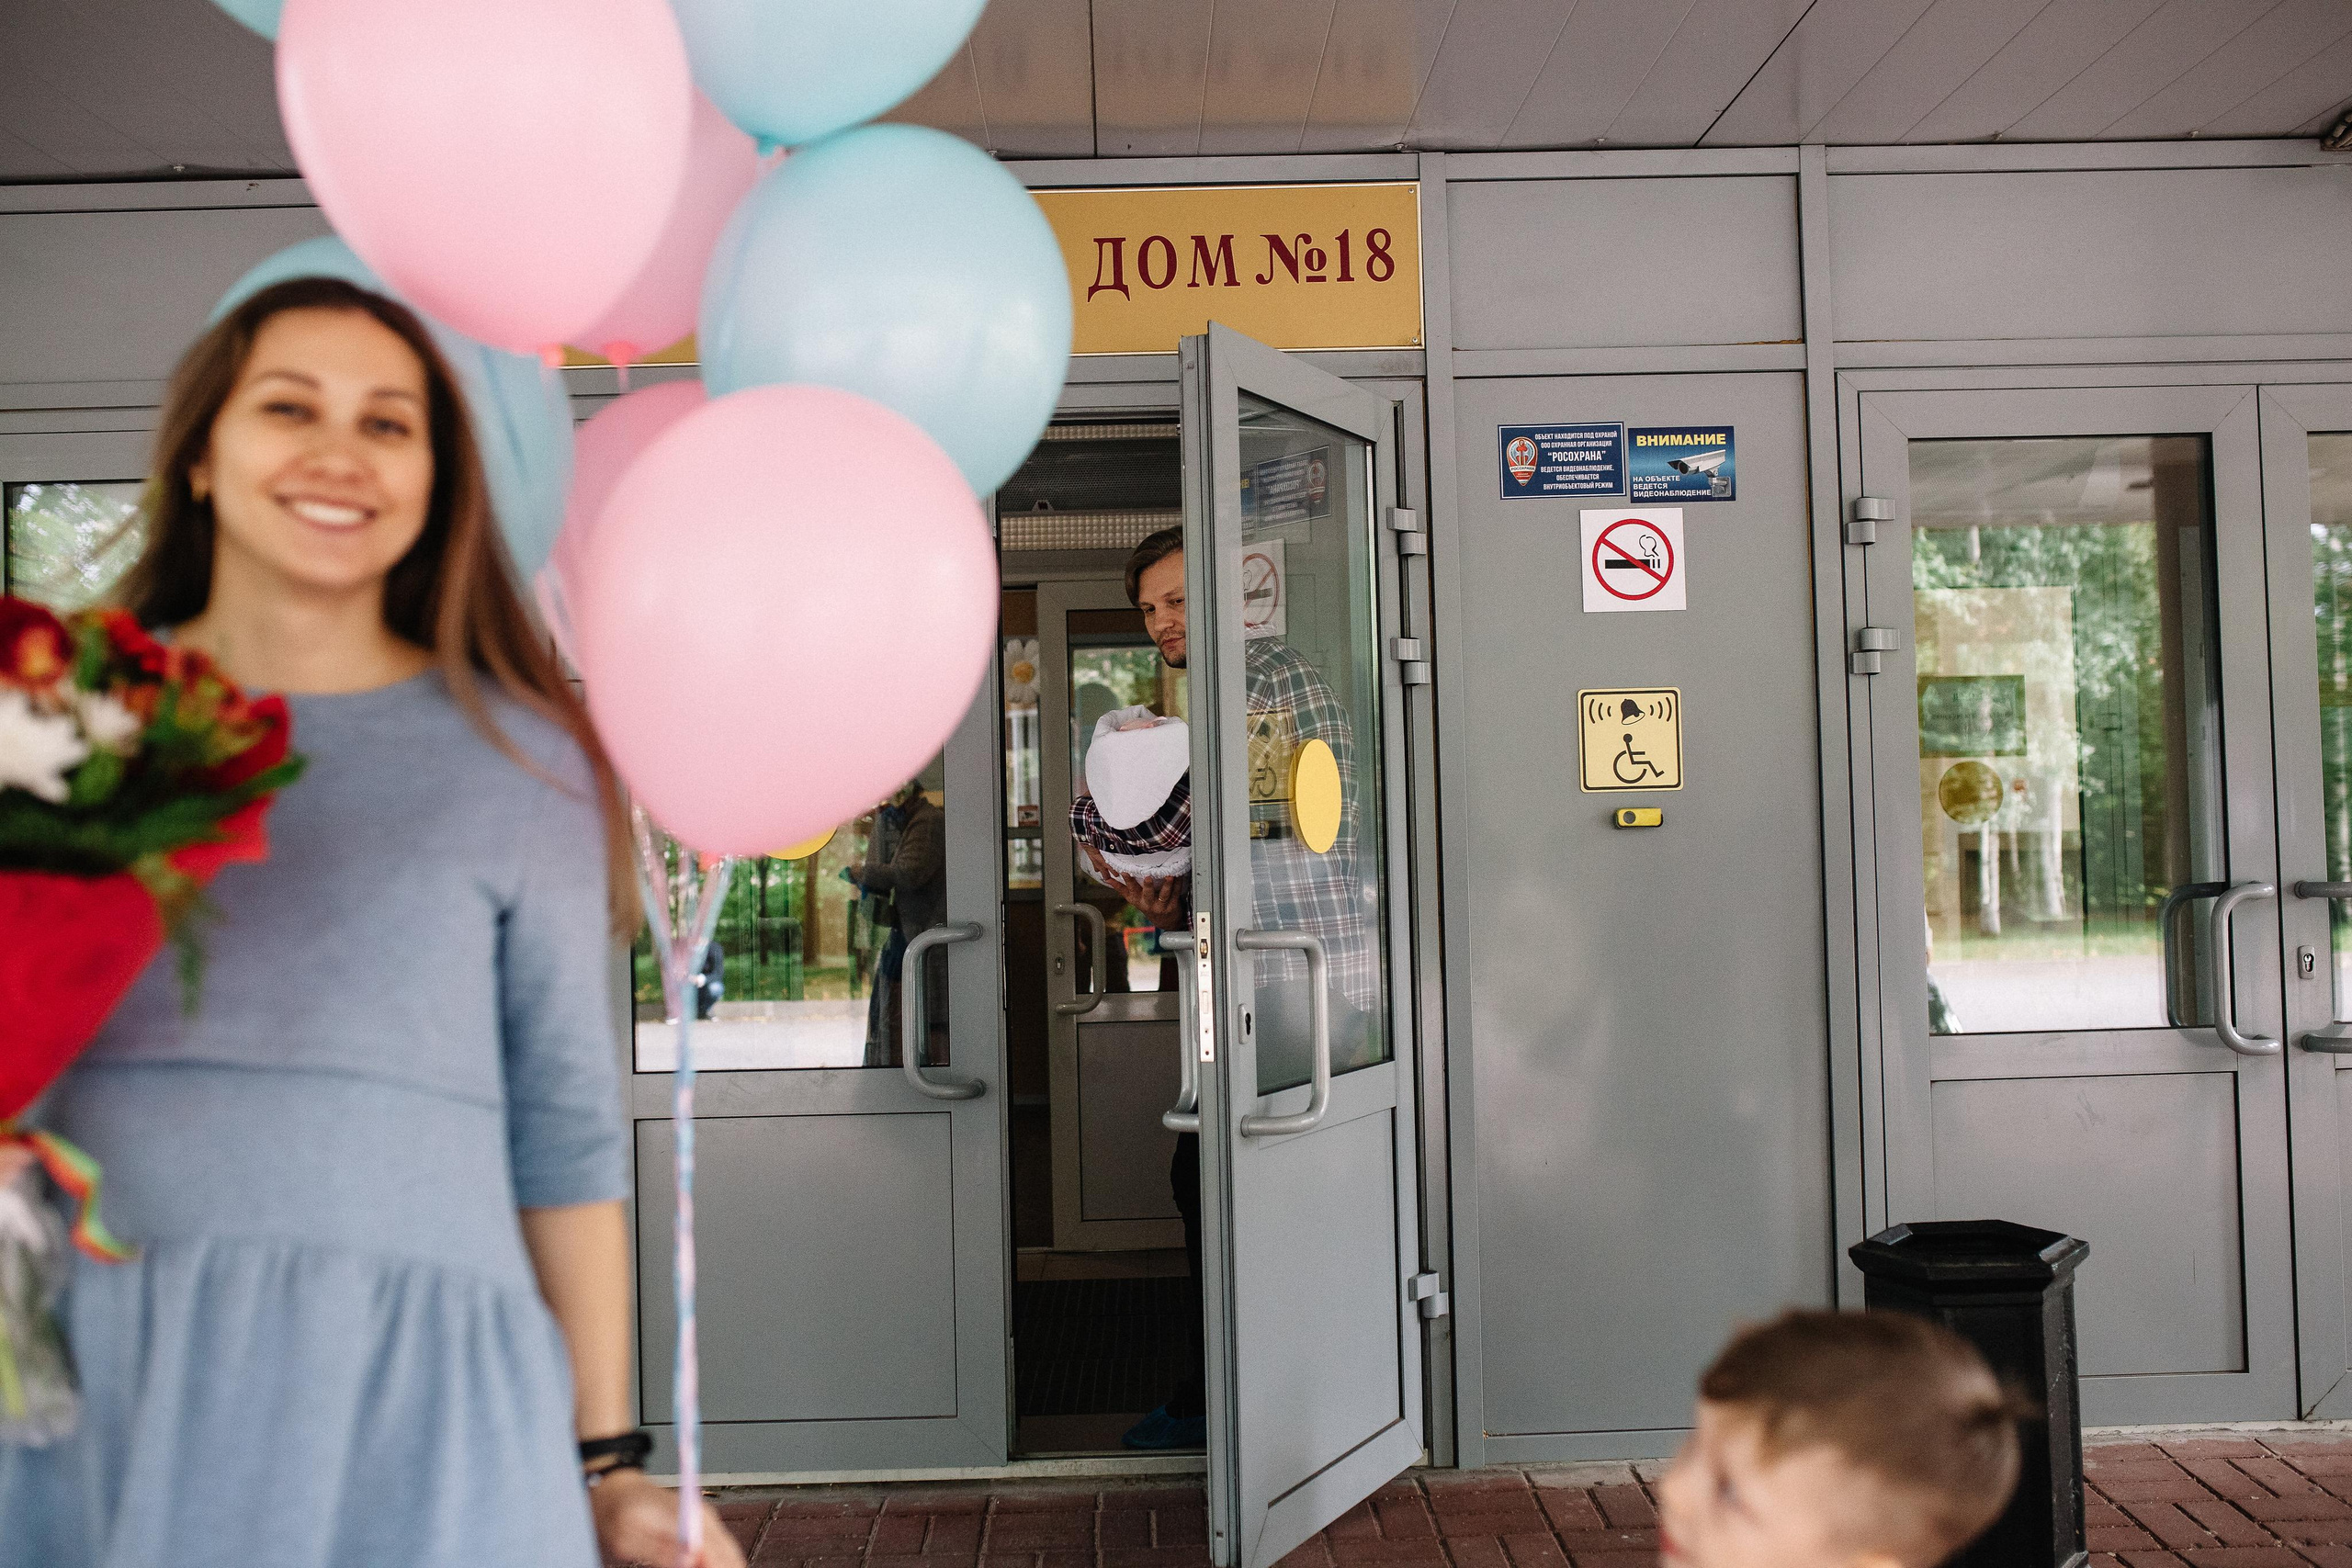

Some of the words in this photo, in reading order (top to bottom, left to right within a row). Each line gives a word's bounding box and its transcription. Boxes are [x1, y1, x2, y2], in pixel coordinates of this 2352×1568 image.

[1087, 234, 1240, 302] ДОМ
[1255, 228, 1396, 285] №18
[1555, 432, 1584, 440] НАХОДИТСЯ
[1595, 430, 1618, 438] ОХРАНОЙ
[1636, 434, 1726, 446] ВНИМАНИЕ
[1544, 481, 1594, 490] ВНУТРИОБЪЕКТОВЫЙ
[1634, 490, 1712, 498] ВИДЕОНАБЛЮДЕНИЕ
